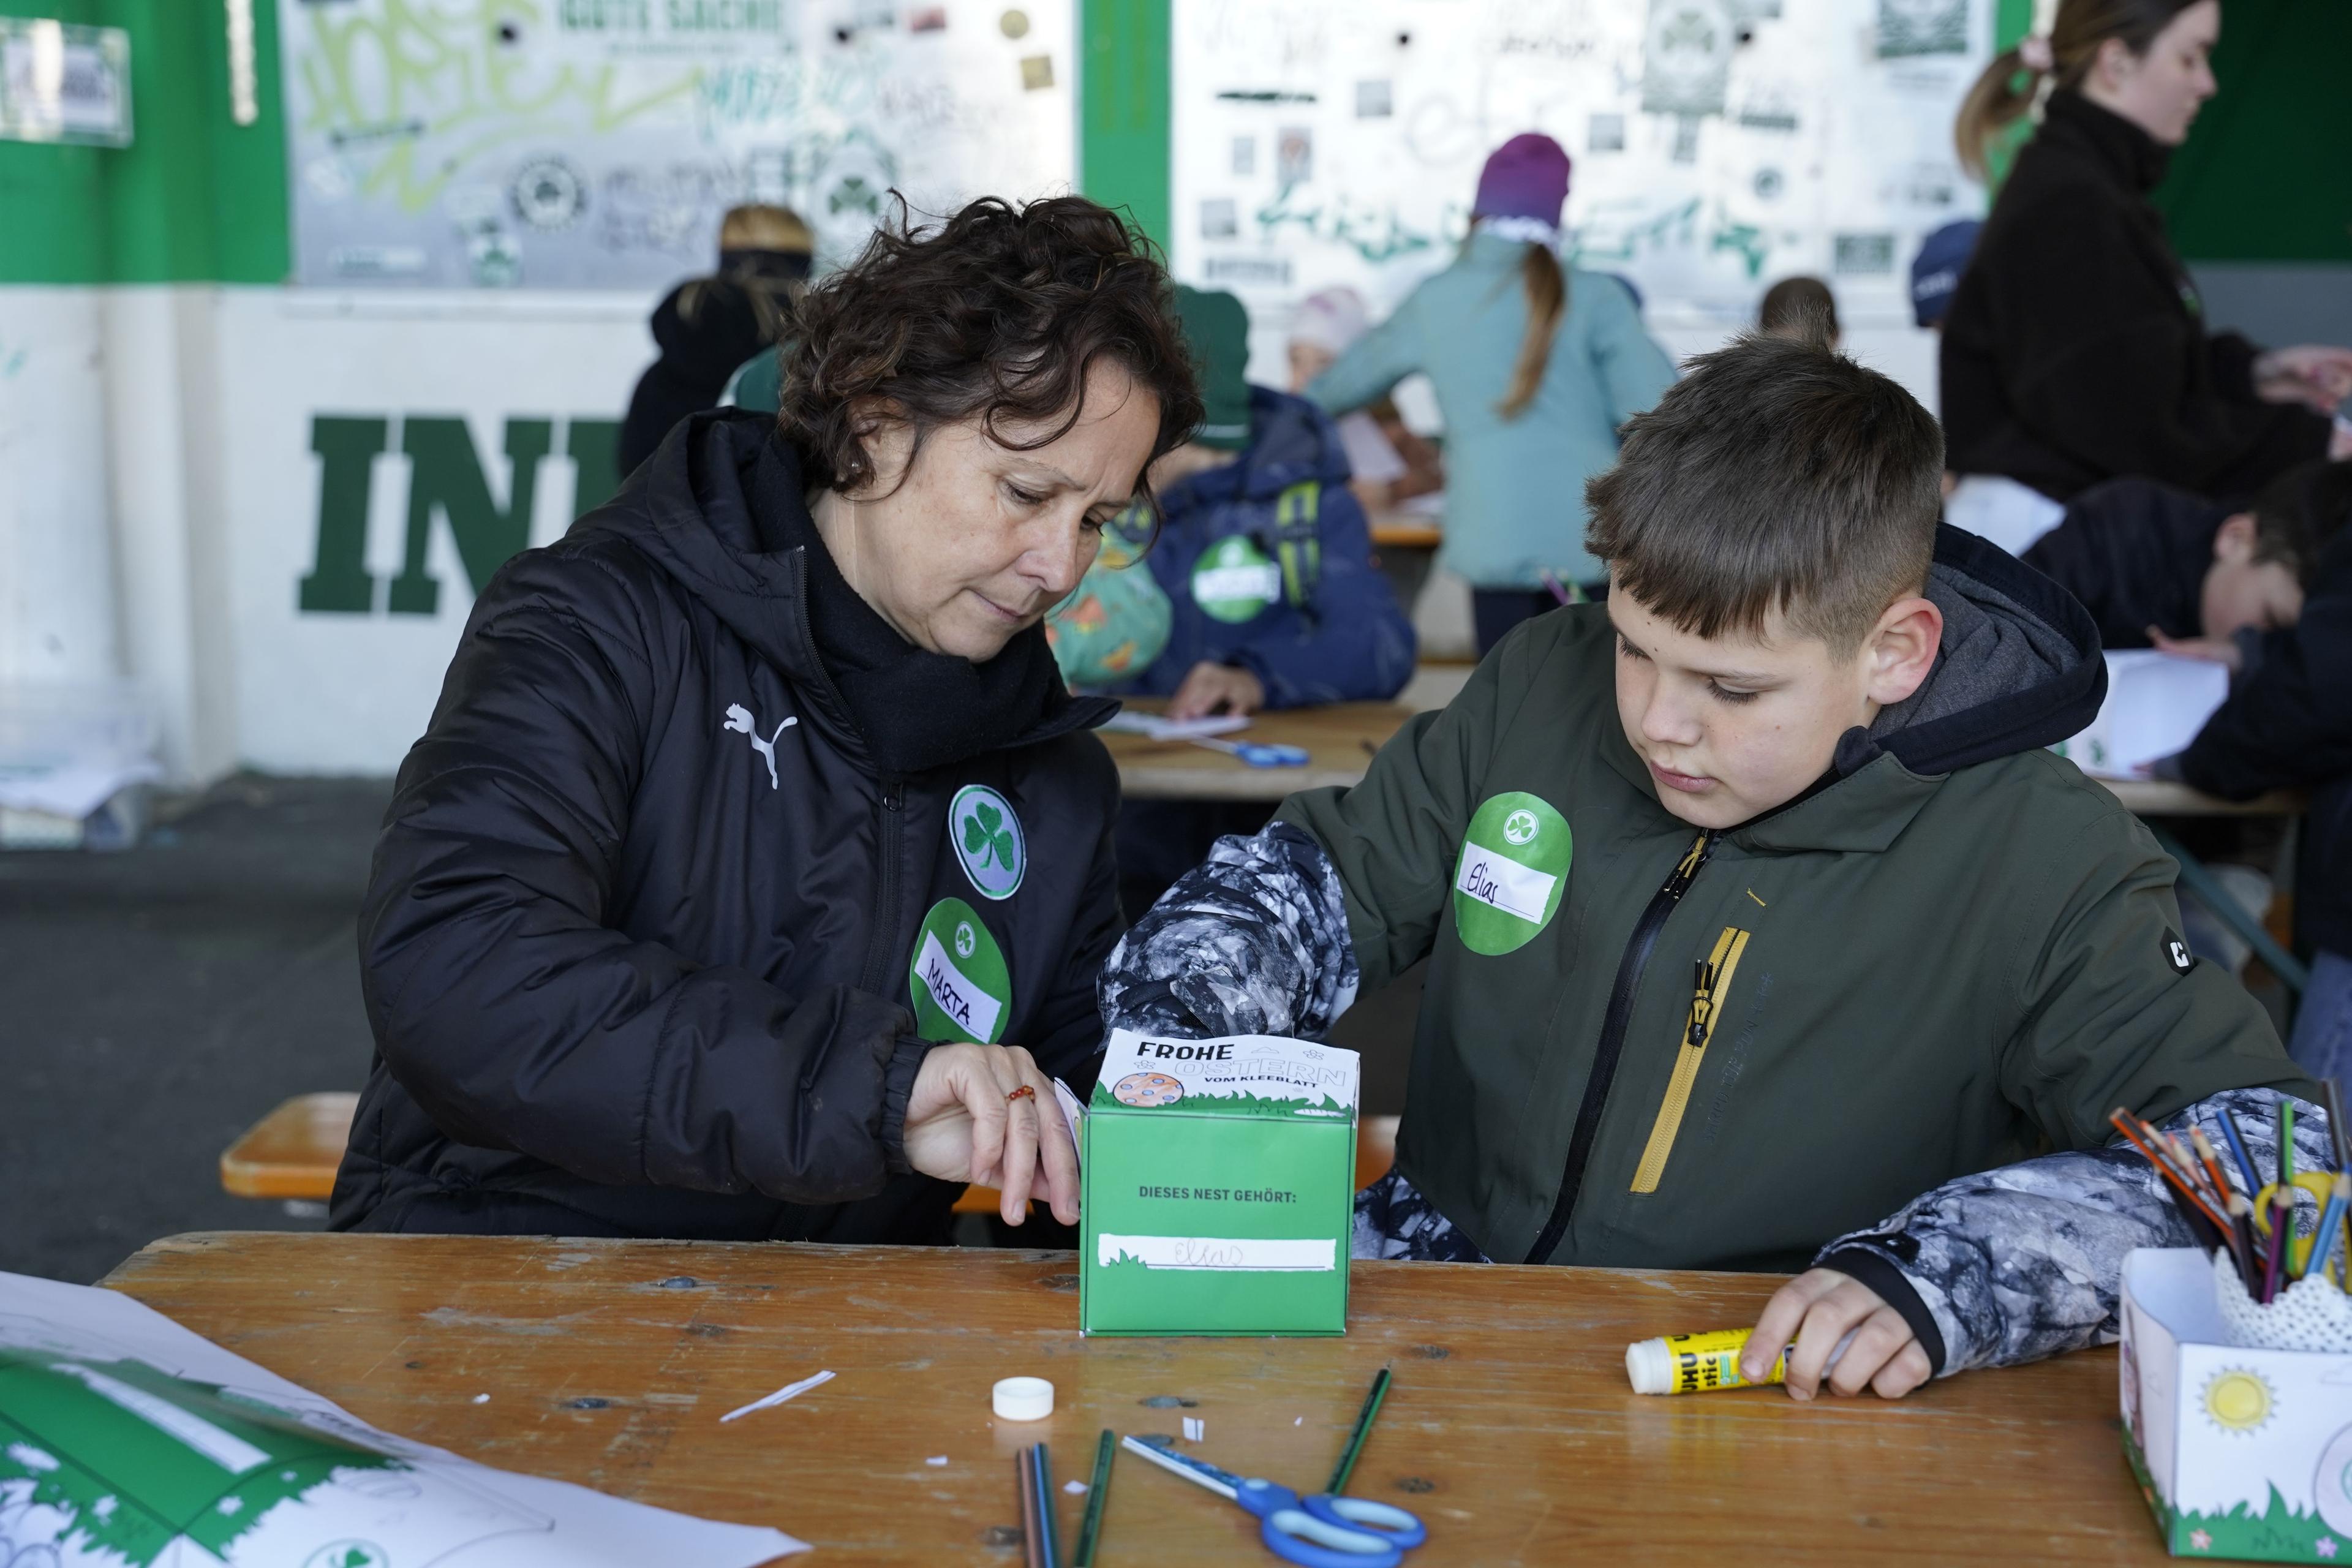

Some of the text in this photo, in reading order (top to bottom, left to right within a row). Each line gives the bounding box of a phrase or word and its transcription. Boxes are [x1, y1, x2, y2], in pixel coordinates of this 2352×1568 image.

[1466, 862, 1499, 903] Elias
[928, 958, 970, 1025] MARTA
[1136, 1041, 1235, 1060] FROHE
[1175, 1058, 1346, 1087] OSTERN
[1240, 1075, 1319, 1088] KLEEBLATT
[1139, 1186, 1297, 1203] DIESES NEST GEHÖRT:
[1679, 1352, 1698, 1391] UHU
[1702, 1357, 1717, 1387] stic
